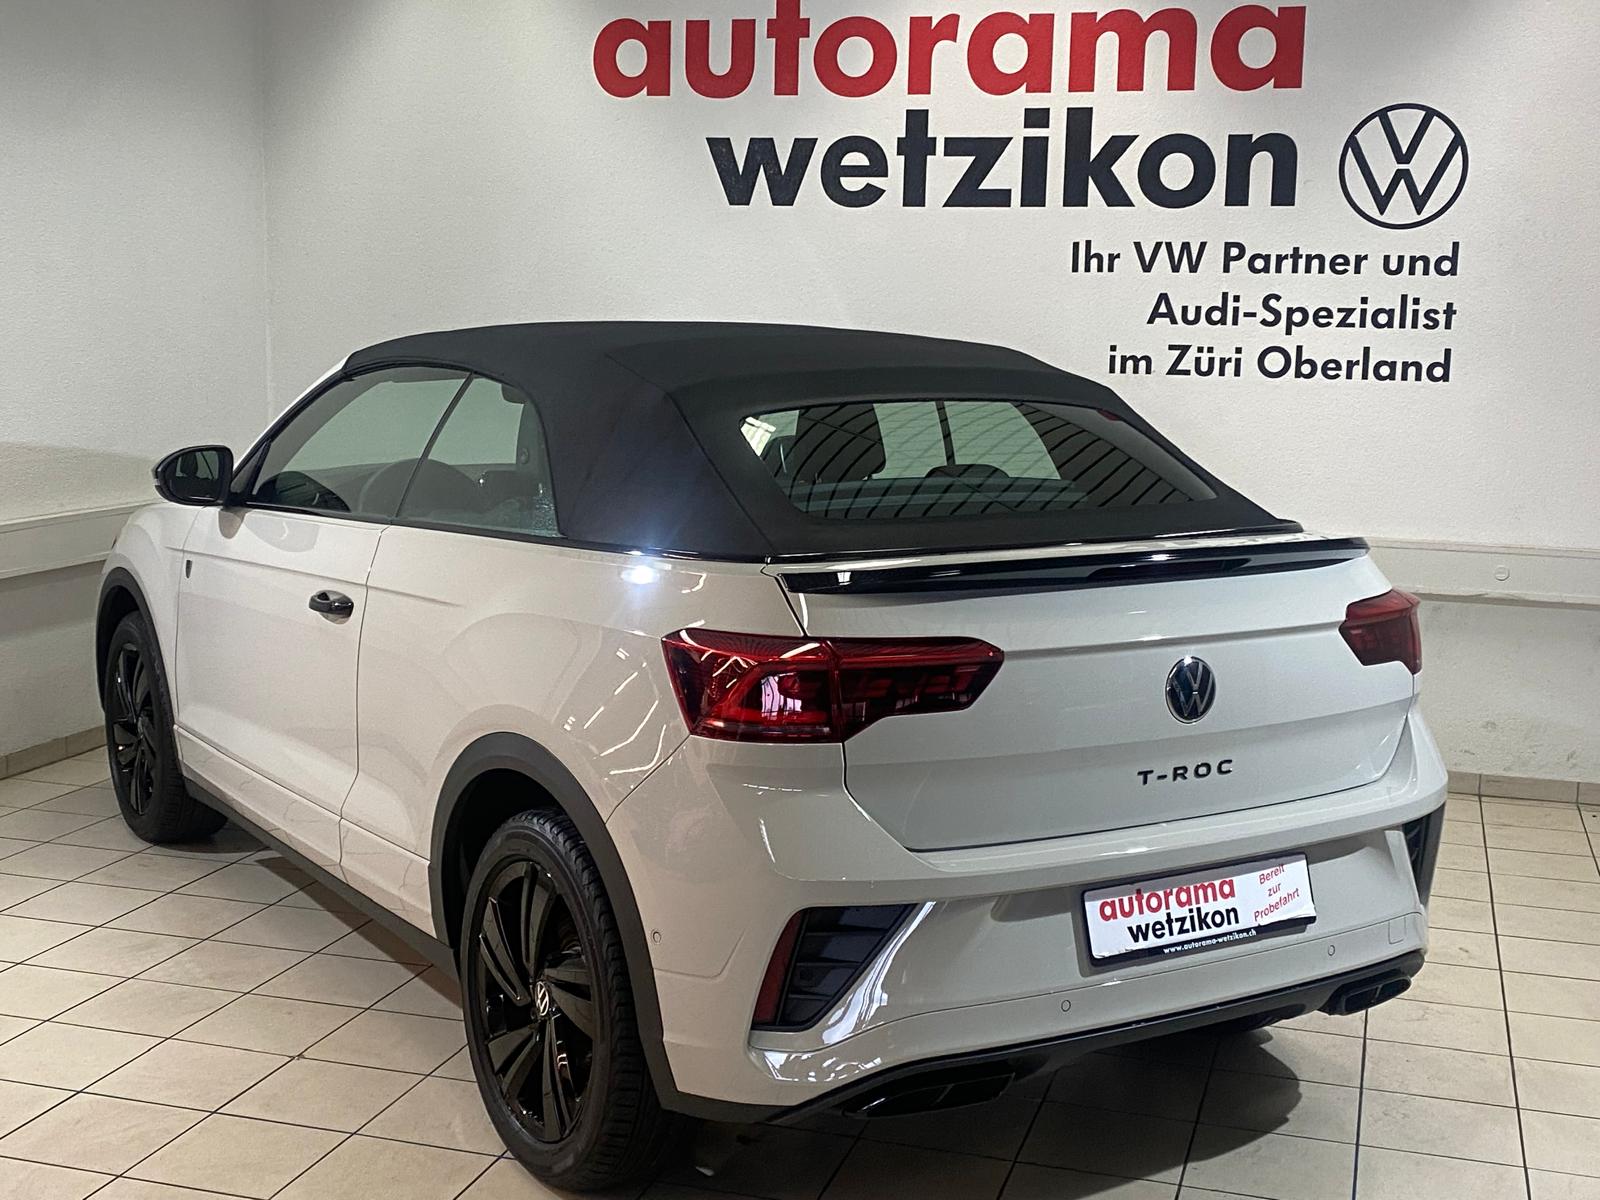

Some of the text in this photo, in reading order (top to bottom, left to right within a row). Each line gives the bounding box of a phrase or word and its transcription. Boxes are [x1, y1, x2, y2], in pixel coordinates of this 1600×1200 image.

[594, 0, 1305, 98] autorama
[706, 107, 1298, 209] wetzikon
[1071, 239, 1460, 277] Ihr VW Partner und
[1147, 292, 1458, 336] Audi-Spezialist
[1108, 344, 1452, 383] im Züri Oberland
[1137, 759, 1233, 786] T-ROC
[1258, 863, 1285, 885] Bereit
[1267, 882, 1282, 898] zur
[1099, 878, 1236, 922] autorama
[1253, 887, 1300, 922] Probefahrt
[1127, 906, 1240, 943] wetzikon
[1163, 928, 1257, 954] www.autorama-wetzikon.ch
